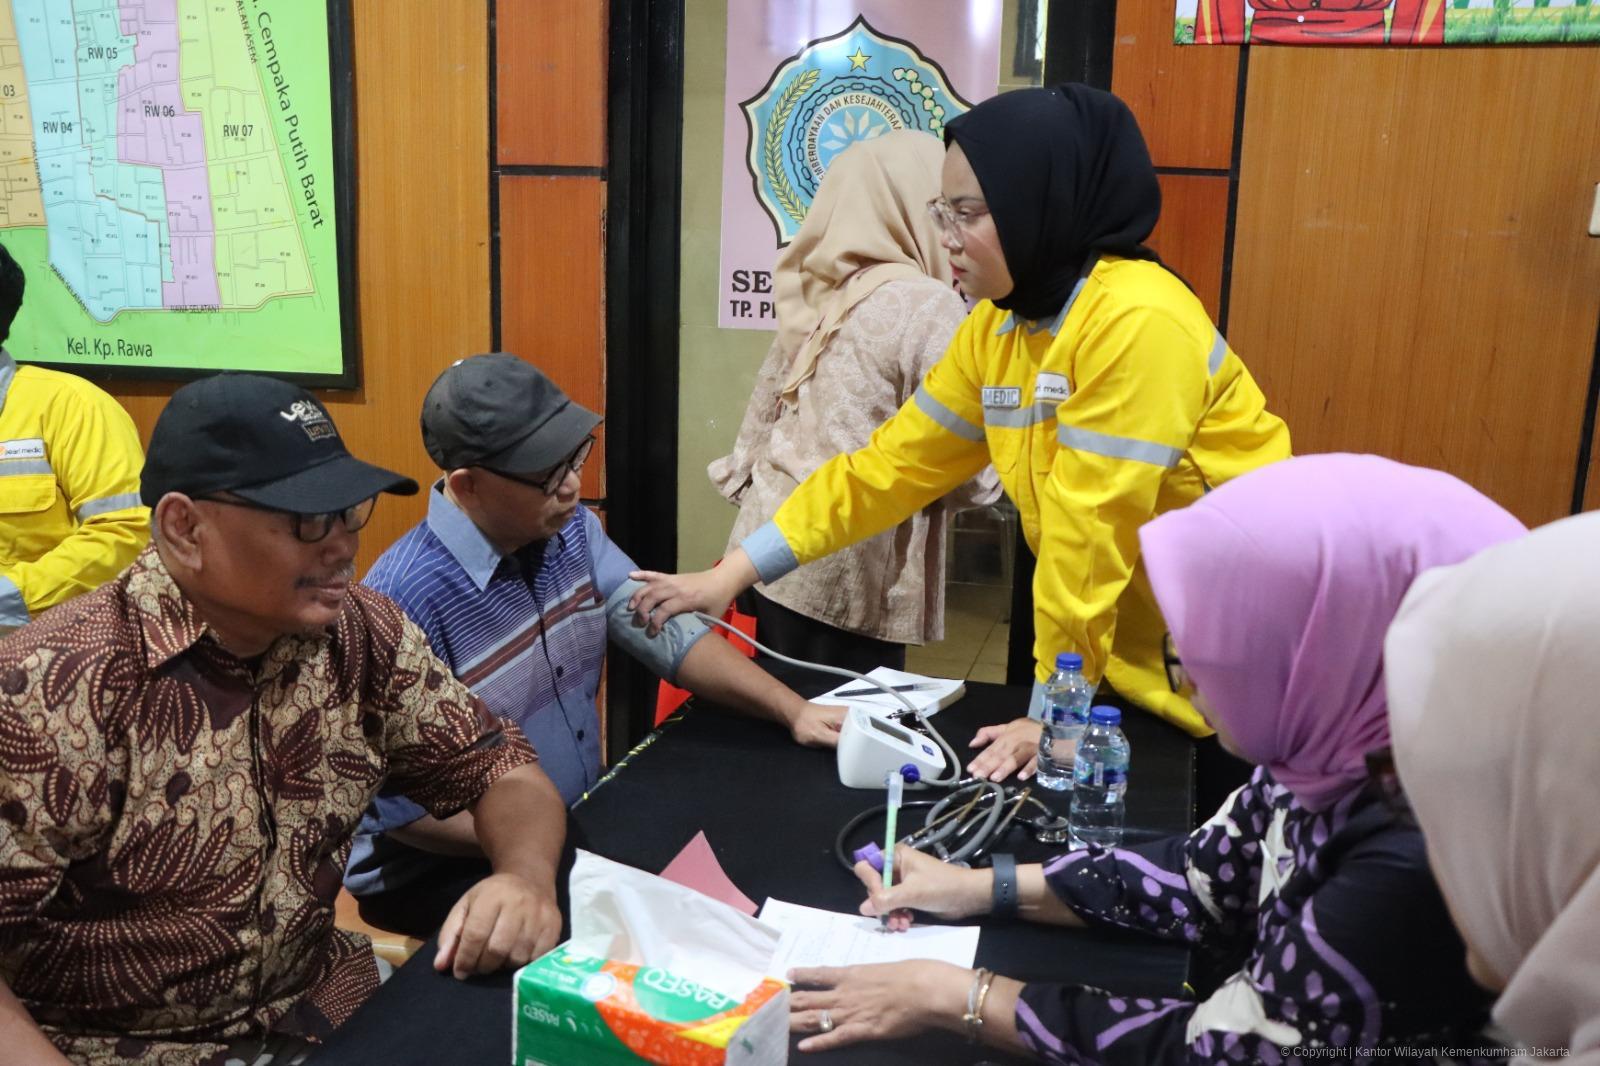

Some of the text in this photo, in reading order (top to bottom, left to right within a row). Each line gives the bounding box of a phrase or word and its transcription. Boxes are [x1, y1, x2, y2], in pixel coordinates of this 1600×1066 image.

[87, 47, 104, 60] RW
[105, 47, 118, 60] 05
[3, 84, 16, 97] 03
[144, 105, 160, 118] RW
[162, 105, 176, 118] 06
[43, 121, 73, 134] RW 04
[258, 11, 324, 230] Cempaka Putih Barat
[223, 124, 254, 137] RW 07
[807, 113, 826, 180] EMBERDAYAAN
[823, 99, 842, 116] DAN
[732, 269, 773, 294] SE
[729, 300, 753, 318] TP.
[67, 336, 153, 360] Kel. Kp. Rawa
[984, 388, 1017, 405] MEDIC
